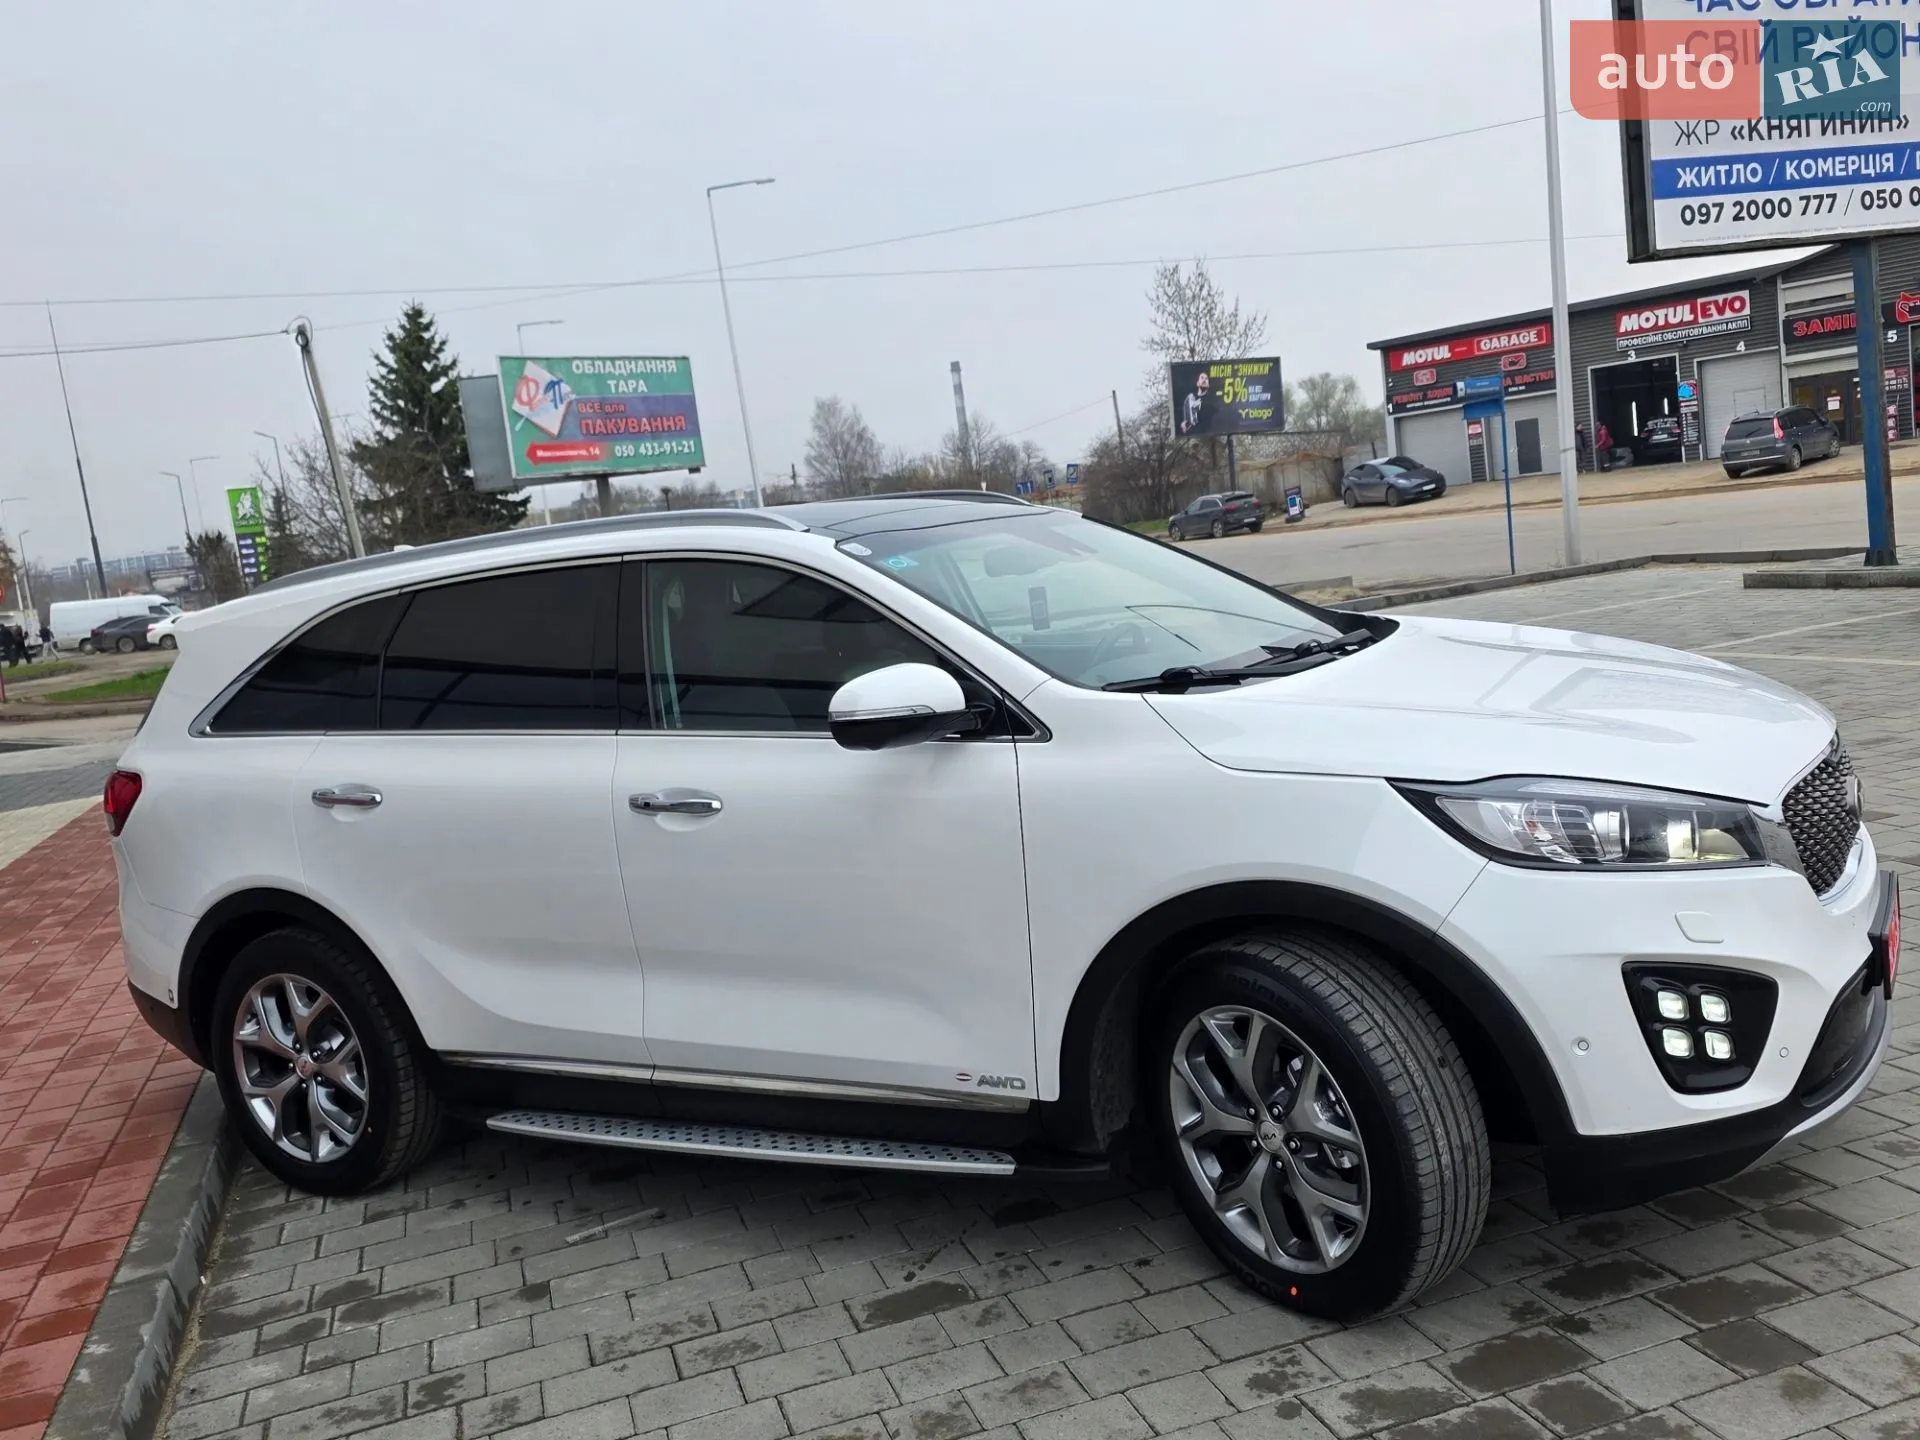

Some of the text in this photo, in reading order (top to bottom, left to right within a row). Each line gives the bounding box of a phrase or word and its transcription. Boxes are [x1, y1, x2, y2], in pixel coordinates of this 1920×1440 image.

[1674, 113, 1910, 146] ЖР «КНЯГИНИН»
[1676, 163, 1763, 189] ЖИТЛО
[1785, 152, 1894, 182] КОМЕРЦІЯ
[1680, 203, 1724, 226] 097
[1732, 198, 1792, 222] 2000
[1799, 193, 1838, 216] 777
[1860, 188, 1901, 211] 050
[1619, 295, 1747, 332] MOTUL EVO
[1480, 331, 1538, 351] GARAGE
[1619, 334, 1663, 348] ПРОФЕСІЙНЕ
[1663, 323, 1727, 340] ОБСЛУГОВУВАННЯ
[1887, 330, 1898, 343] 5
[1402, 344, 1452, 366] MOTUL
[1627, 350, 1636, 361] 3
[1736, 341, 1746, 352] 4
[572, 360, 677, 376] ОБЛАДНАННЯ
[607, 380, 648, 393] ТАРА
[1216, 377, 1248, 404] -5%
[578, 403, 625, 414] ВСЕ для
[1387, 402, 1393, 413] 1
[581, 415, 687, 435] ПАКУВАННЯ
[615, 440, 695, 457] 050 433-91-21
[976, 1074, 1026, 1091] AWD
